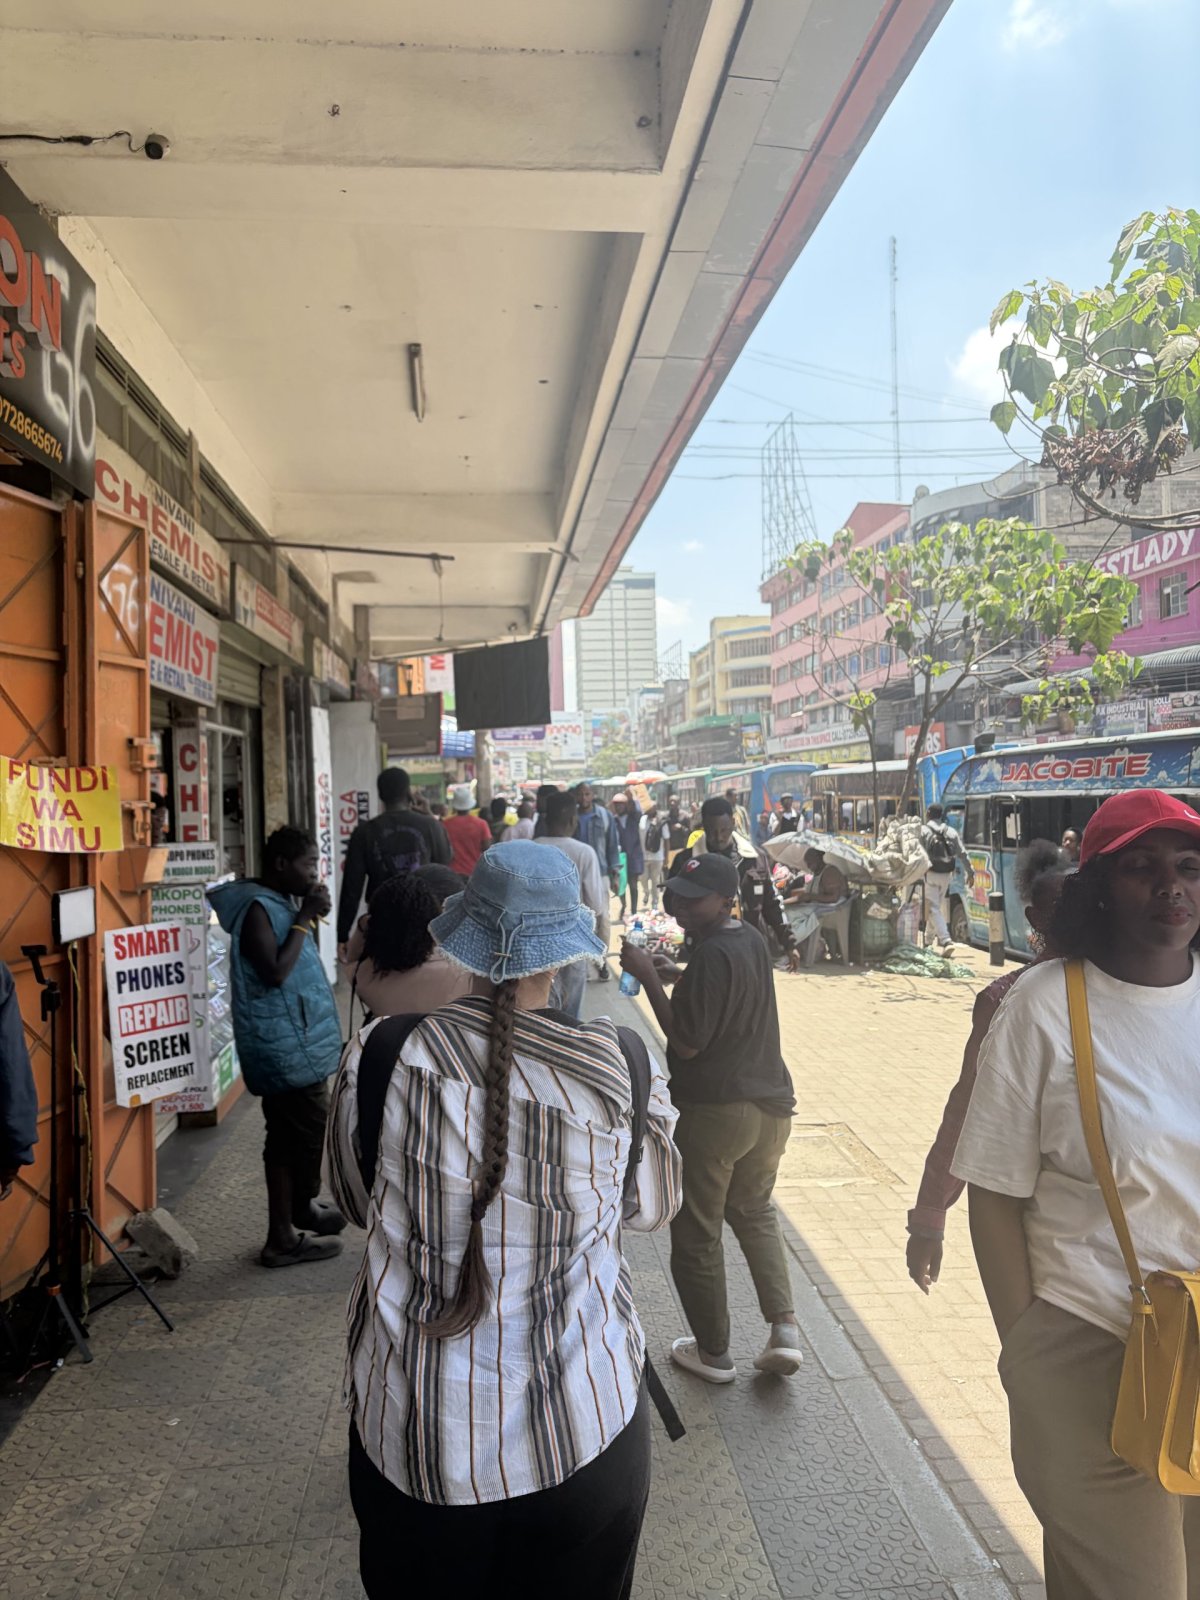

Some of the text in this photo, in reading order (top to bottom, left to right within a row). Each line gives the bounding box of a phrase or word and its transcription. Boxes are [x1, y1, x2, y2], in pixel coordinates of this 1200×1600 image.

[95, 459, 228, 594] CHEMIST
[164, 664, 187, 692] RETAIL
[1107, 699, 1146, 714] INDUSTRIAL
[9, 759, 109, 793] FUNDI
[1002, 753, 1152, 781] JACOBITE
[31, 796, 83, 821] WA
[17, 822, 101, 851] SIMU
[340, 790, 358, 872] EGA
[168, 849, 215, 862] OPO PHONES
[152, 904, 201, 914] PHONES
[114, 928, 181, 961] SMART
[116, 961, 186, 994] PHONES
[119, 996, 189, 1036] REPAIR
[124, 1032, 192, 1069] SCREEN
[127, 1062, 195, 1091] REPLACEMENT
